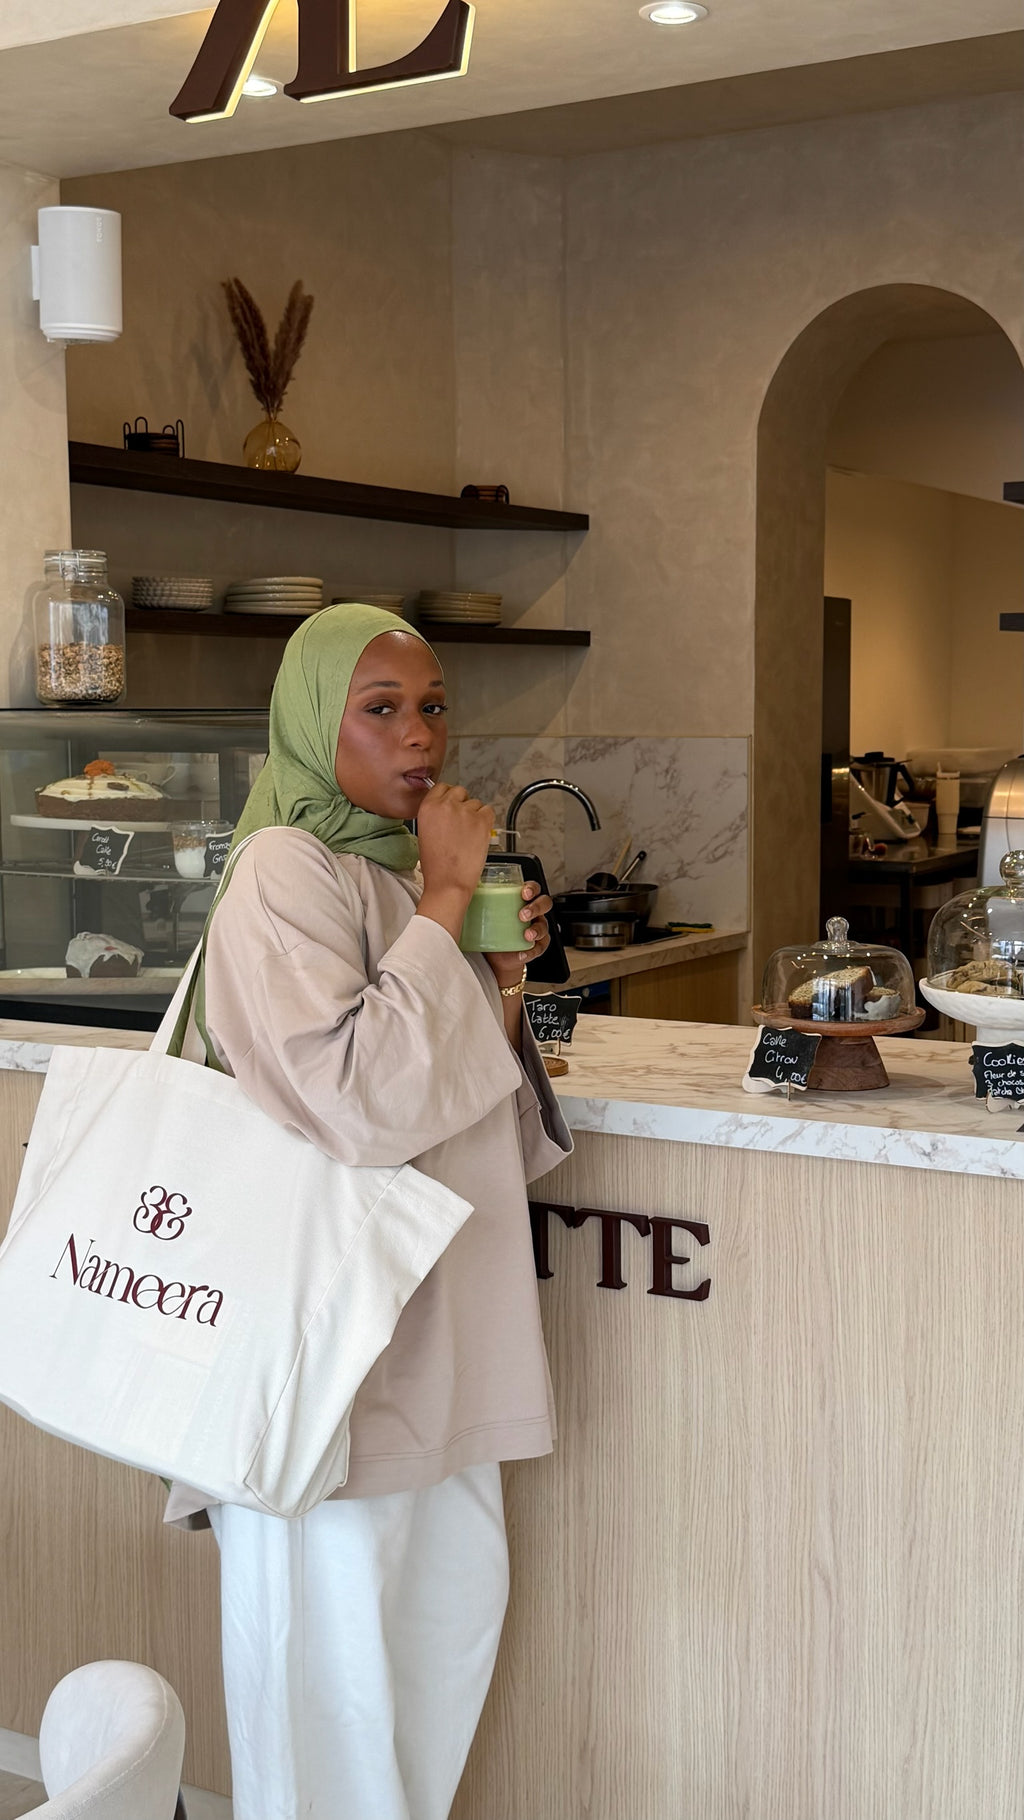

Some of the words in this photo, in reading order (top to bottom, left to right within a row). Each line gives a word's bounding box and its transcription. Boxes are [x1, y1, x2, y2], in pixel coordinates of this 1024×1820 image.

[526, 999, 557, 1011] Taro
[762, 1032, 787, 1047] Cake
[983, 1070, 1005, 1080] Fleur
[1007, 1069, 1017, 1078] de
[49, 1233, 224, 1327] Nameera
